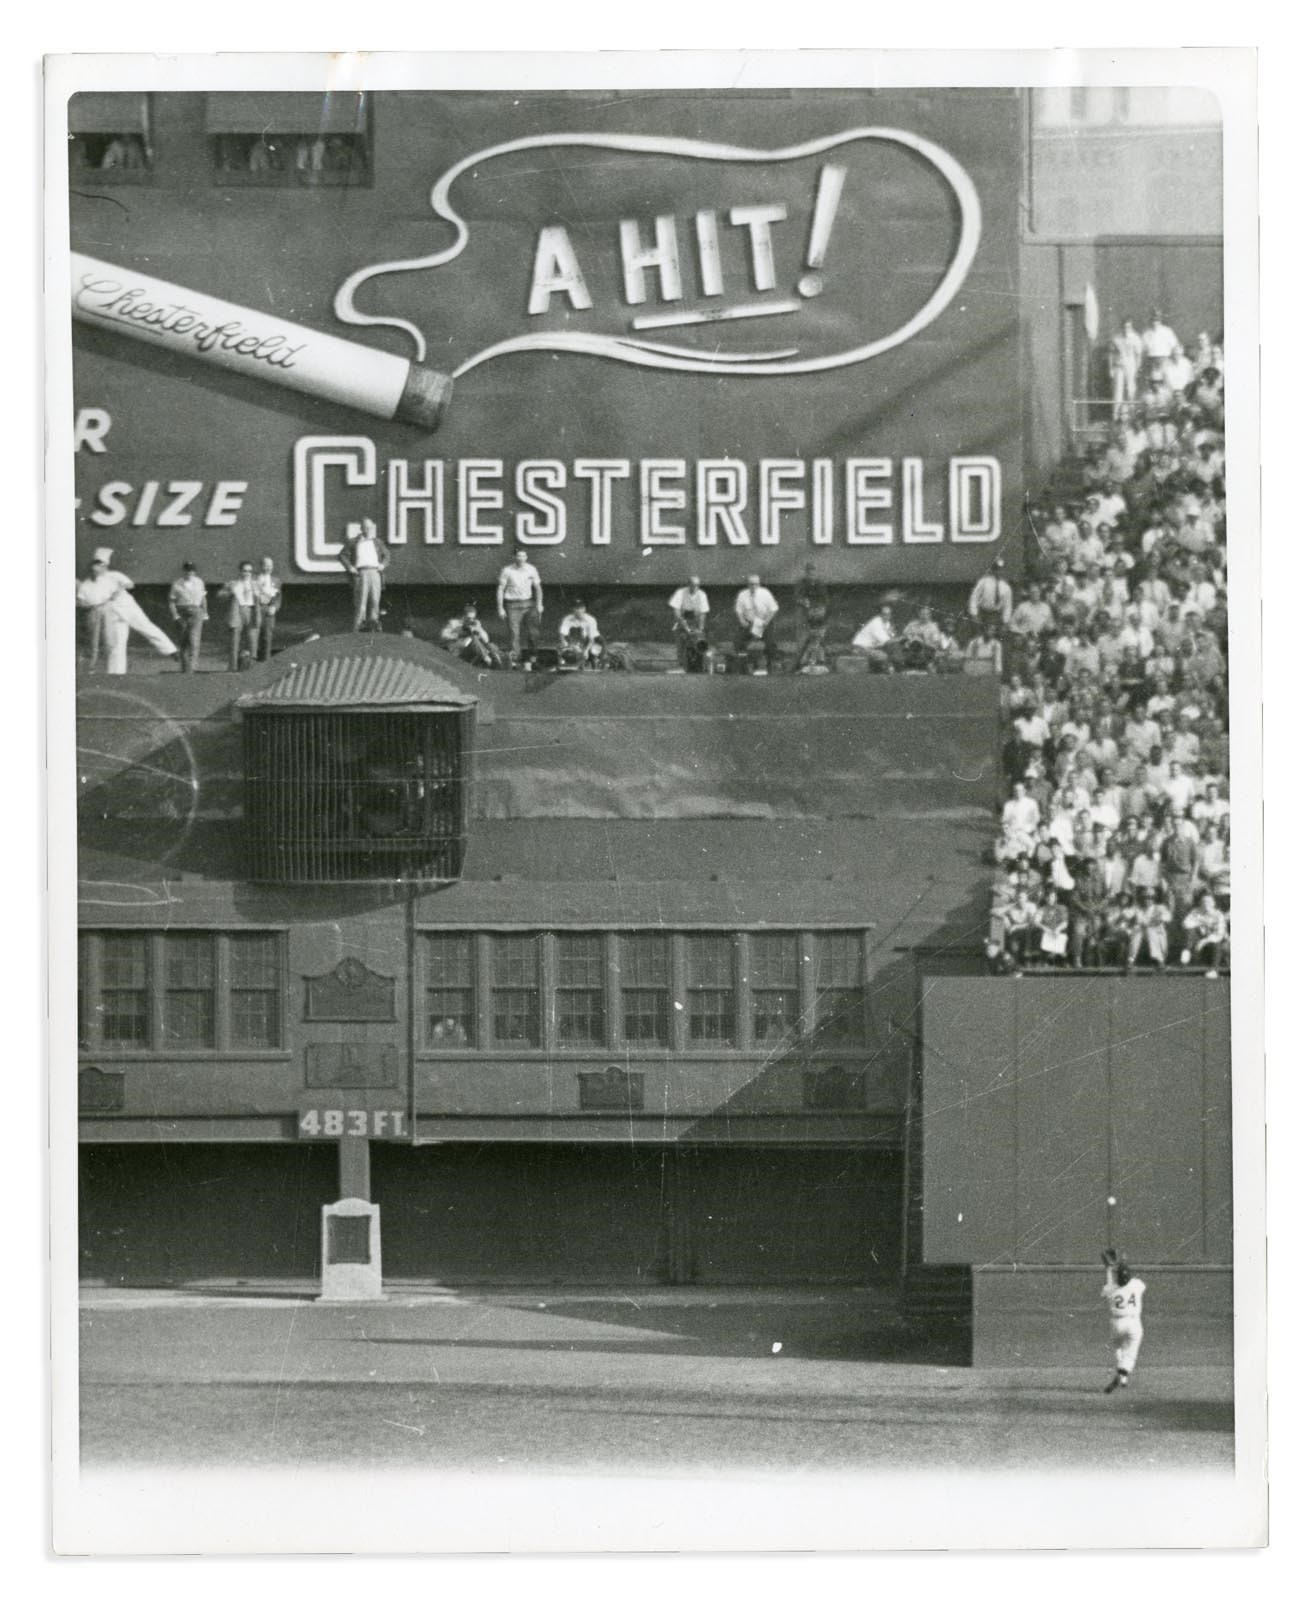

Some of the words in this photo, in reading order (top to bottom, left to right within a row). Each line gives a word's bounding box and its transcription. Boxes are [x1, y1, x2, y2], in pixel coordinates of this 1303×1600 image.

[528, 226, 593, 315] A
[619, 164, 847, 304] HIT!
[76, 273, 307, 369] Chesterfield
[294, 435, 1002, 572] CHESTERFIELD
[300, 1110, 368, 1136] 483
[374, 1111, 408, 1136] FT.
[1114, 1293, 1136, 1309] 24
